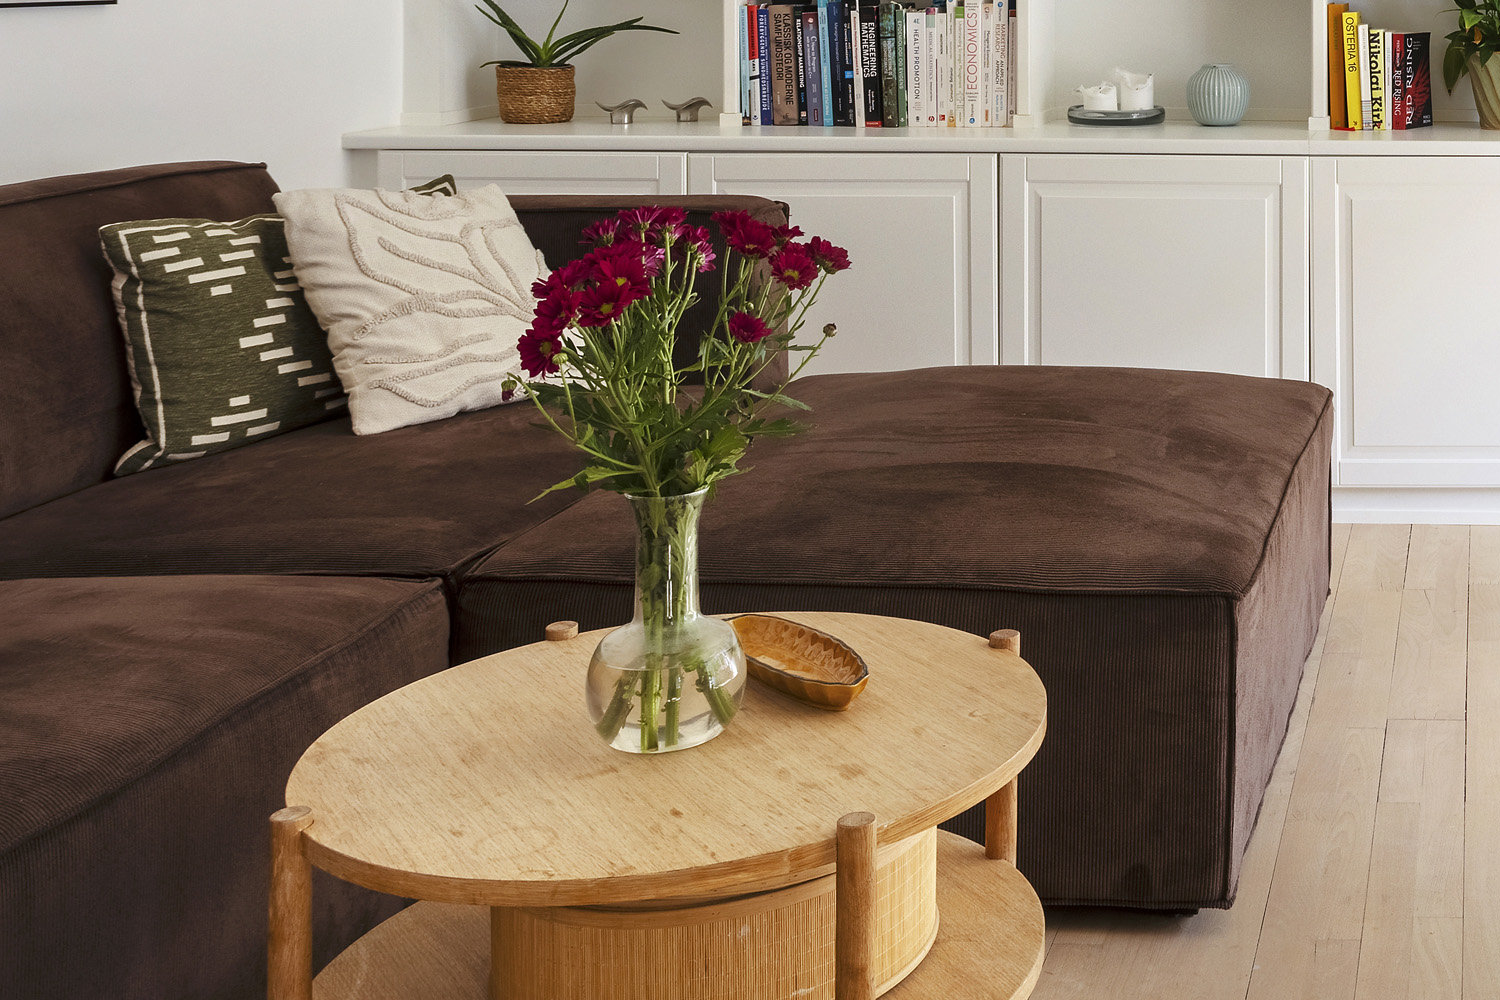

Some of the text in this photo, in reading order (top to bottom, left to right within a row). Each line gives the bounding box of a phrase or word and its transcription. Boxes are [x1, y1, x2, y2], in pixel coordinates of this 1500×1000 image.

[774, 13, 784, 81] SAMFUNDSTEORI
[783, 13, 794, 105] KLASSISK OG MODERNE
[861, 22, 871, 78] MATHEMATICS
[868, 22, 878, 77] ENGINEERING
[966, 12, 978, 90] ECONOMICS
[1345, 17, 1357, 73] OSTERIA 16
[1393, 69, 1402, 87] RED
[1393, 88, 1402, 116] RISING
[1406, 37, 1415, 125] RED RISING
[1372, 96, 1383, 129] Kirk
